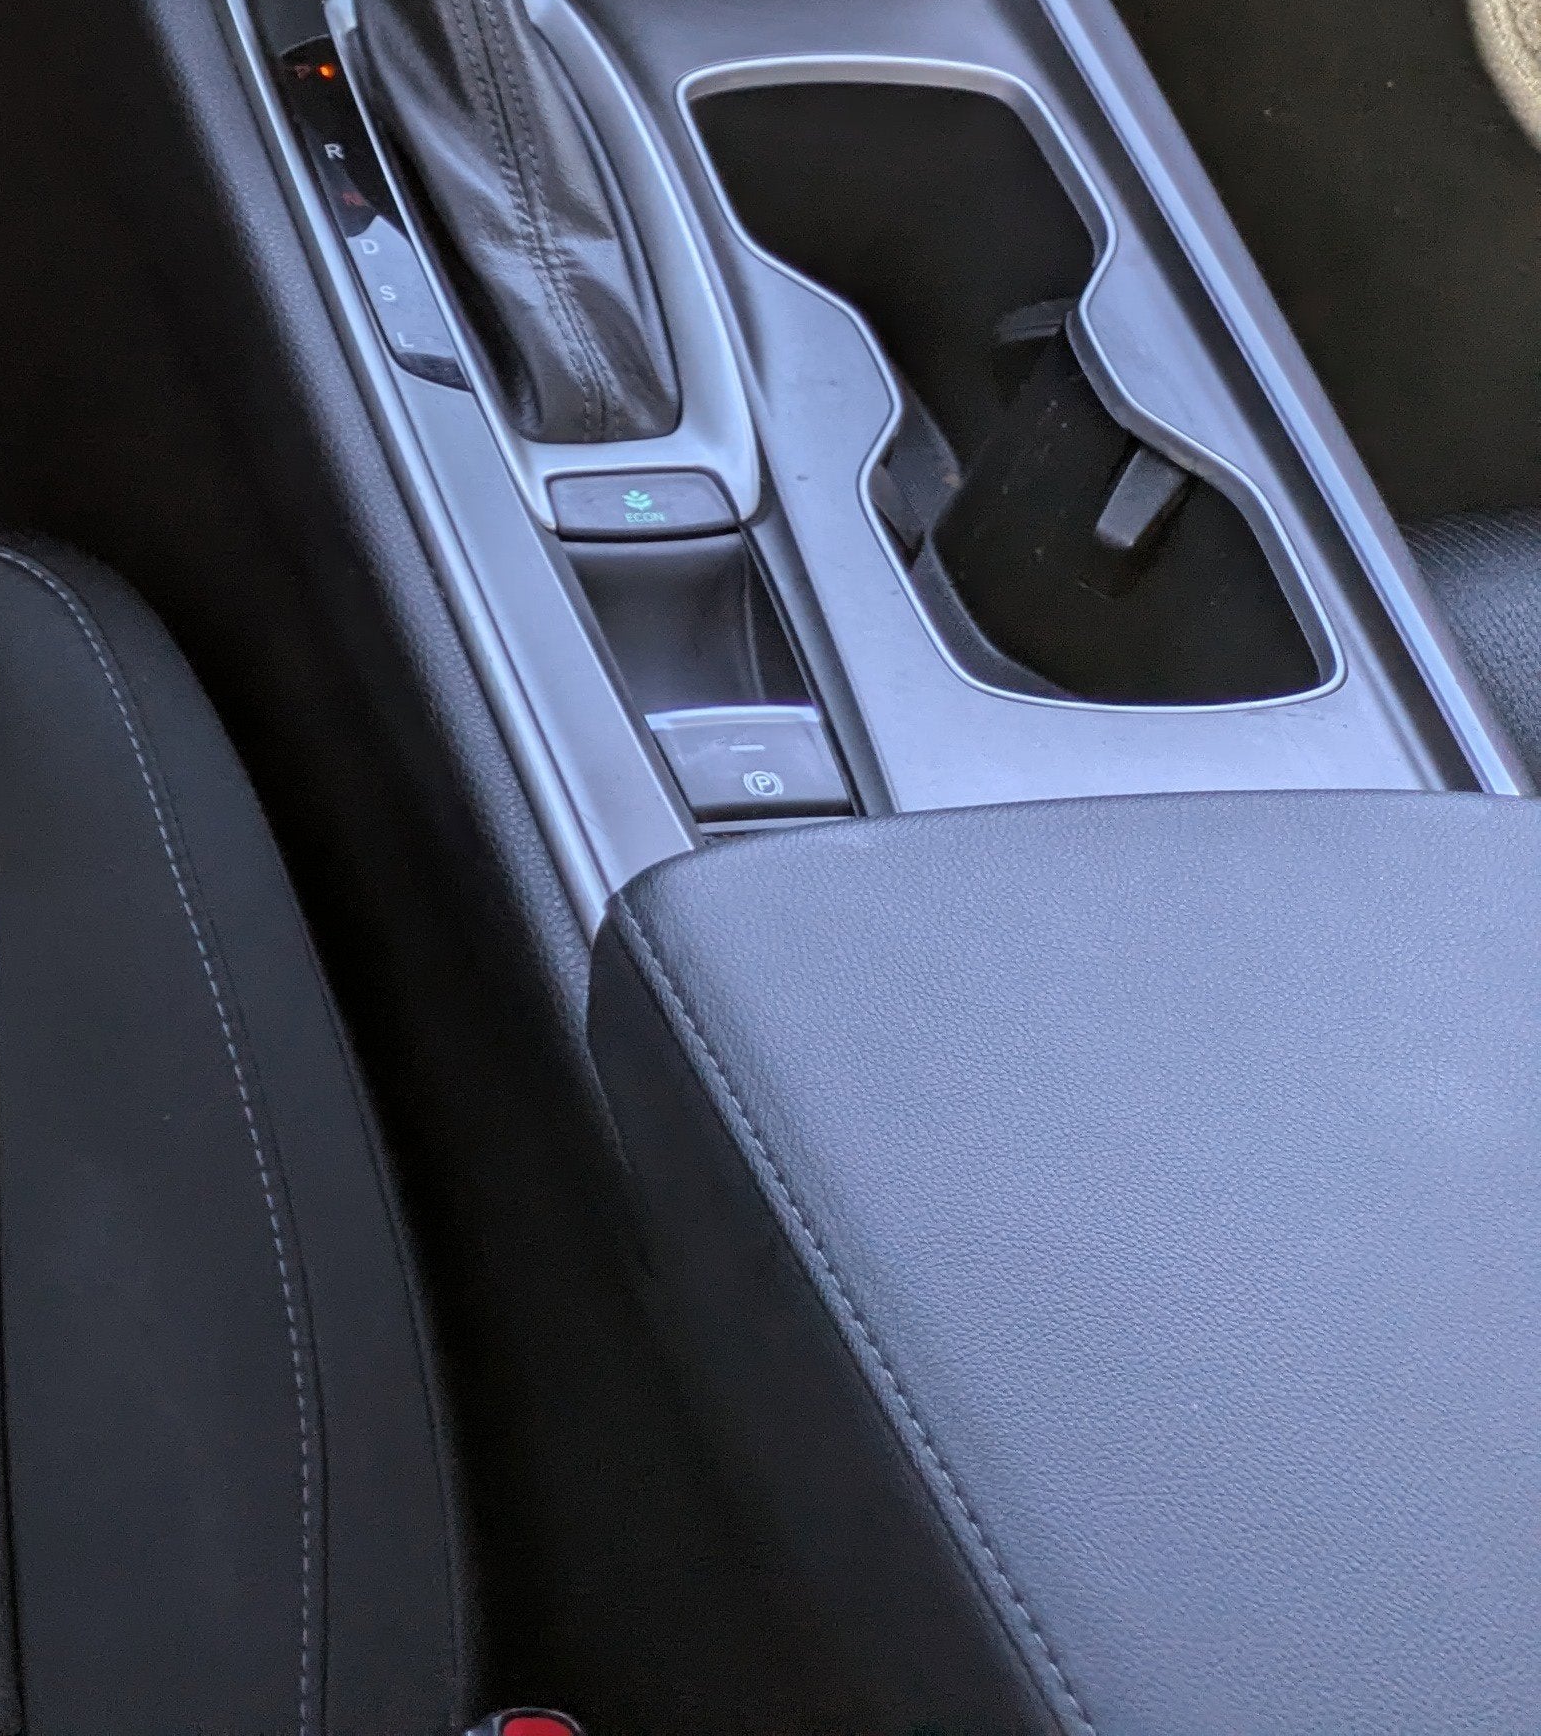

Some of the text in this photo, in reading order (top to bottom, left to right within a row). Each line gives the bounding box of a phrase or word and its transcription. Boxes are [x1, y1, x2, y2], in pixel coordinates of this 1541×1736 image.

[324, 143, 343, 158] R
[359, 238, 377, 253] D
[379, 284, 395, 299] S
[397, 331, 412, 347] L
[625, 512, 665, 522] ECON
